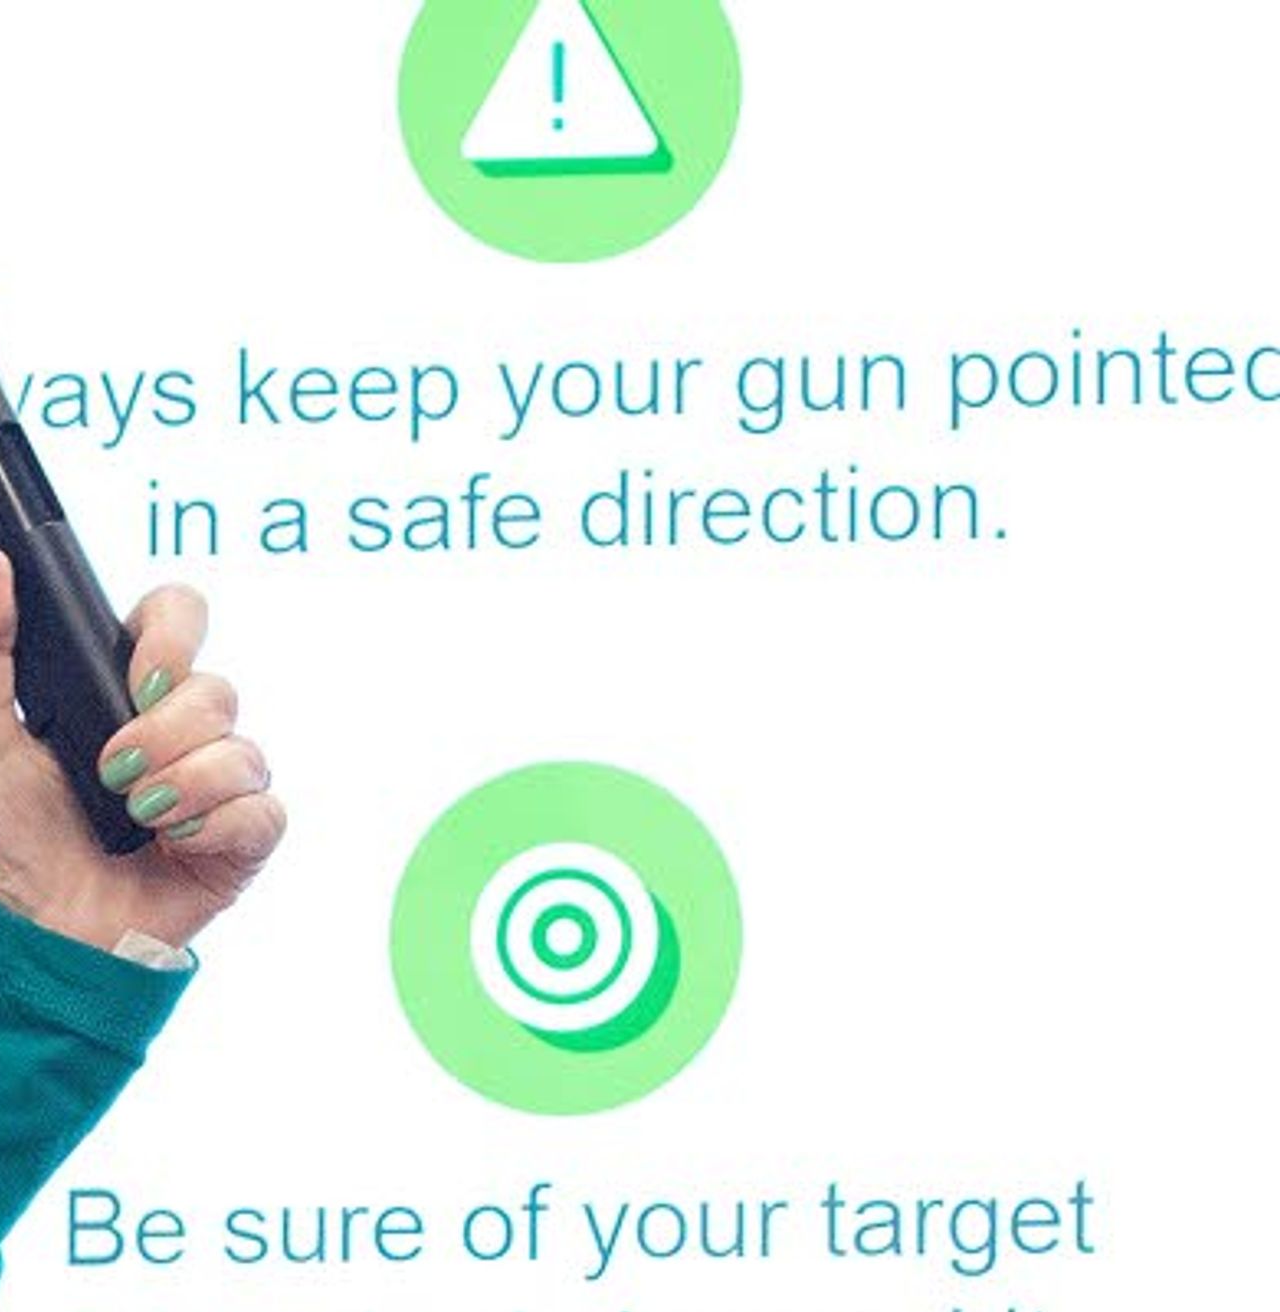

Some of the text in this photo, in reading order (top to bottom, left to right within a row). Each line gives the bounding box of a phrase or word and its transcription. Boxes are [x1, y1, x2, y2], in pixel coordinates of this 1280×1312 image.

[238, 346, 459, 444] keep
[498, 358, 704, 441] your
[736, 353, 906, 435] gun
[148, 463, 1007, 557] in a safe direction.
[68, 1180, 1095, 1282] Be sure of your target
